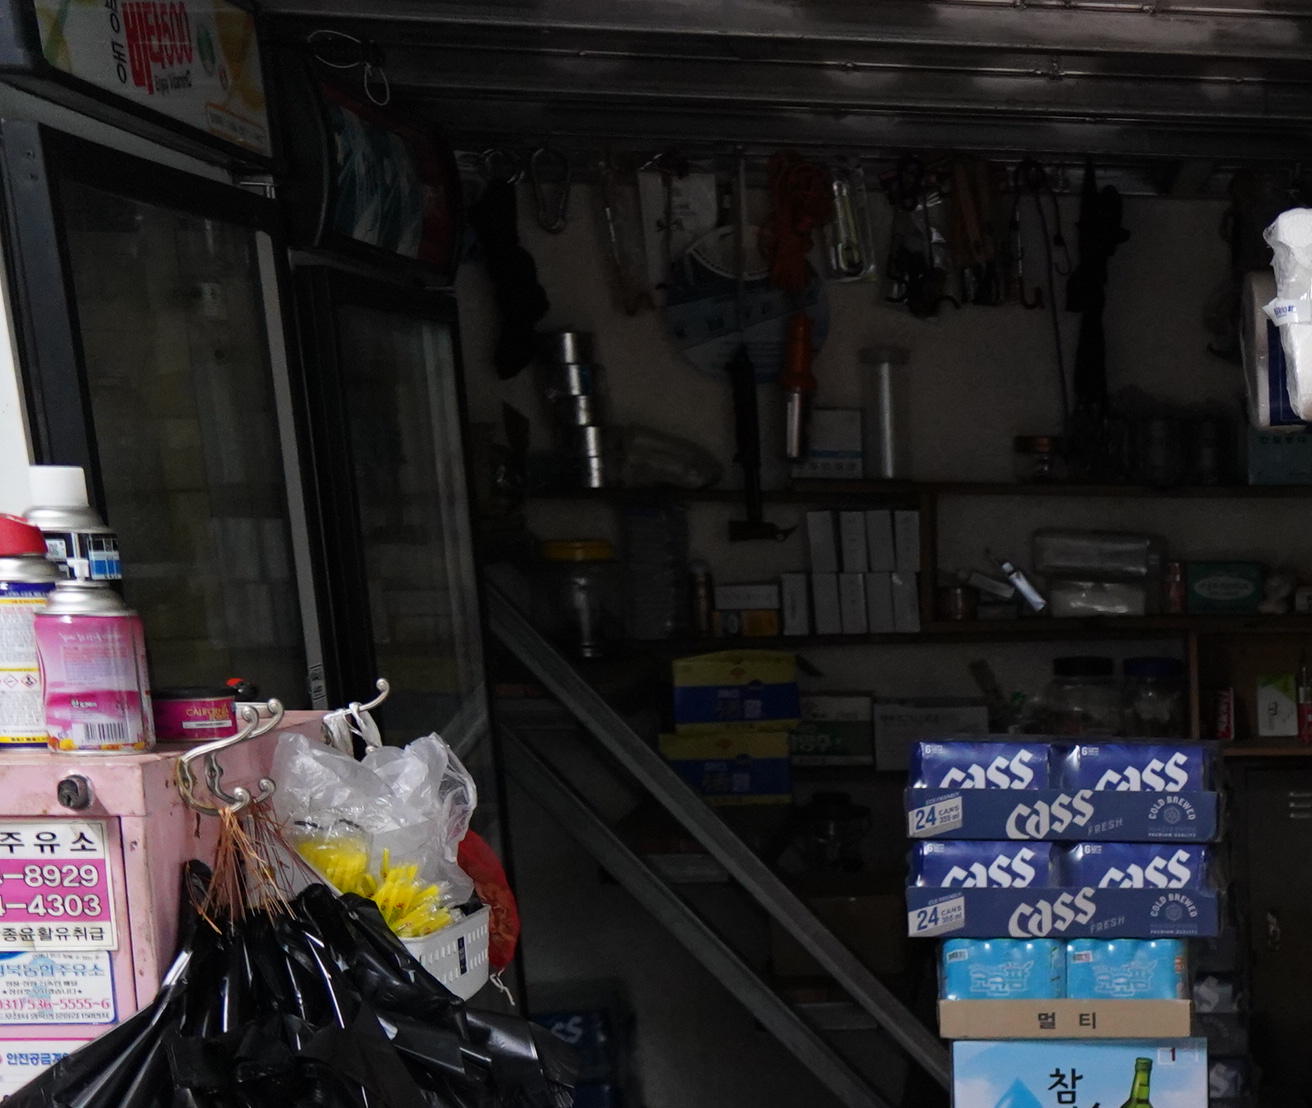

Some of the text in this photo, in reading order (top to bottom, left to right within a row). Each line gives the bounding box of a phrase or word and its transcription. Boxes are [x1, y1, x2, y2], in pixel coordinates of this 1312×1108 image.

[915, 804, 961, 832] 24 CANS
[1005, 788, 1095, 840] CASS
[1166, 795, 1197, 822] BREWED
[1087, 817, 1124, 836] FRESH
[916, 905, 962, 931] 24 CANS
[1007, 886, 1096, 939] CASS
[1167, 892, 1198, 919] BREWED
[1089, 915, 1125, 935] FRESH
[1048, 1067, 1084, 1105] 참
